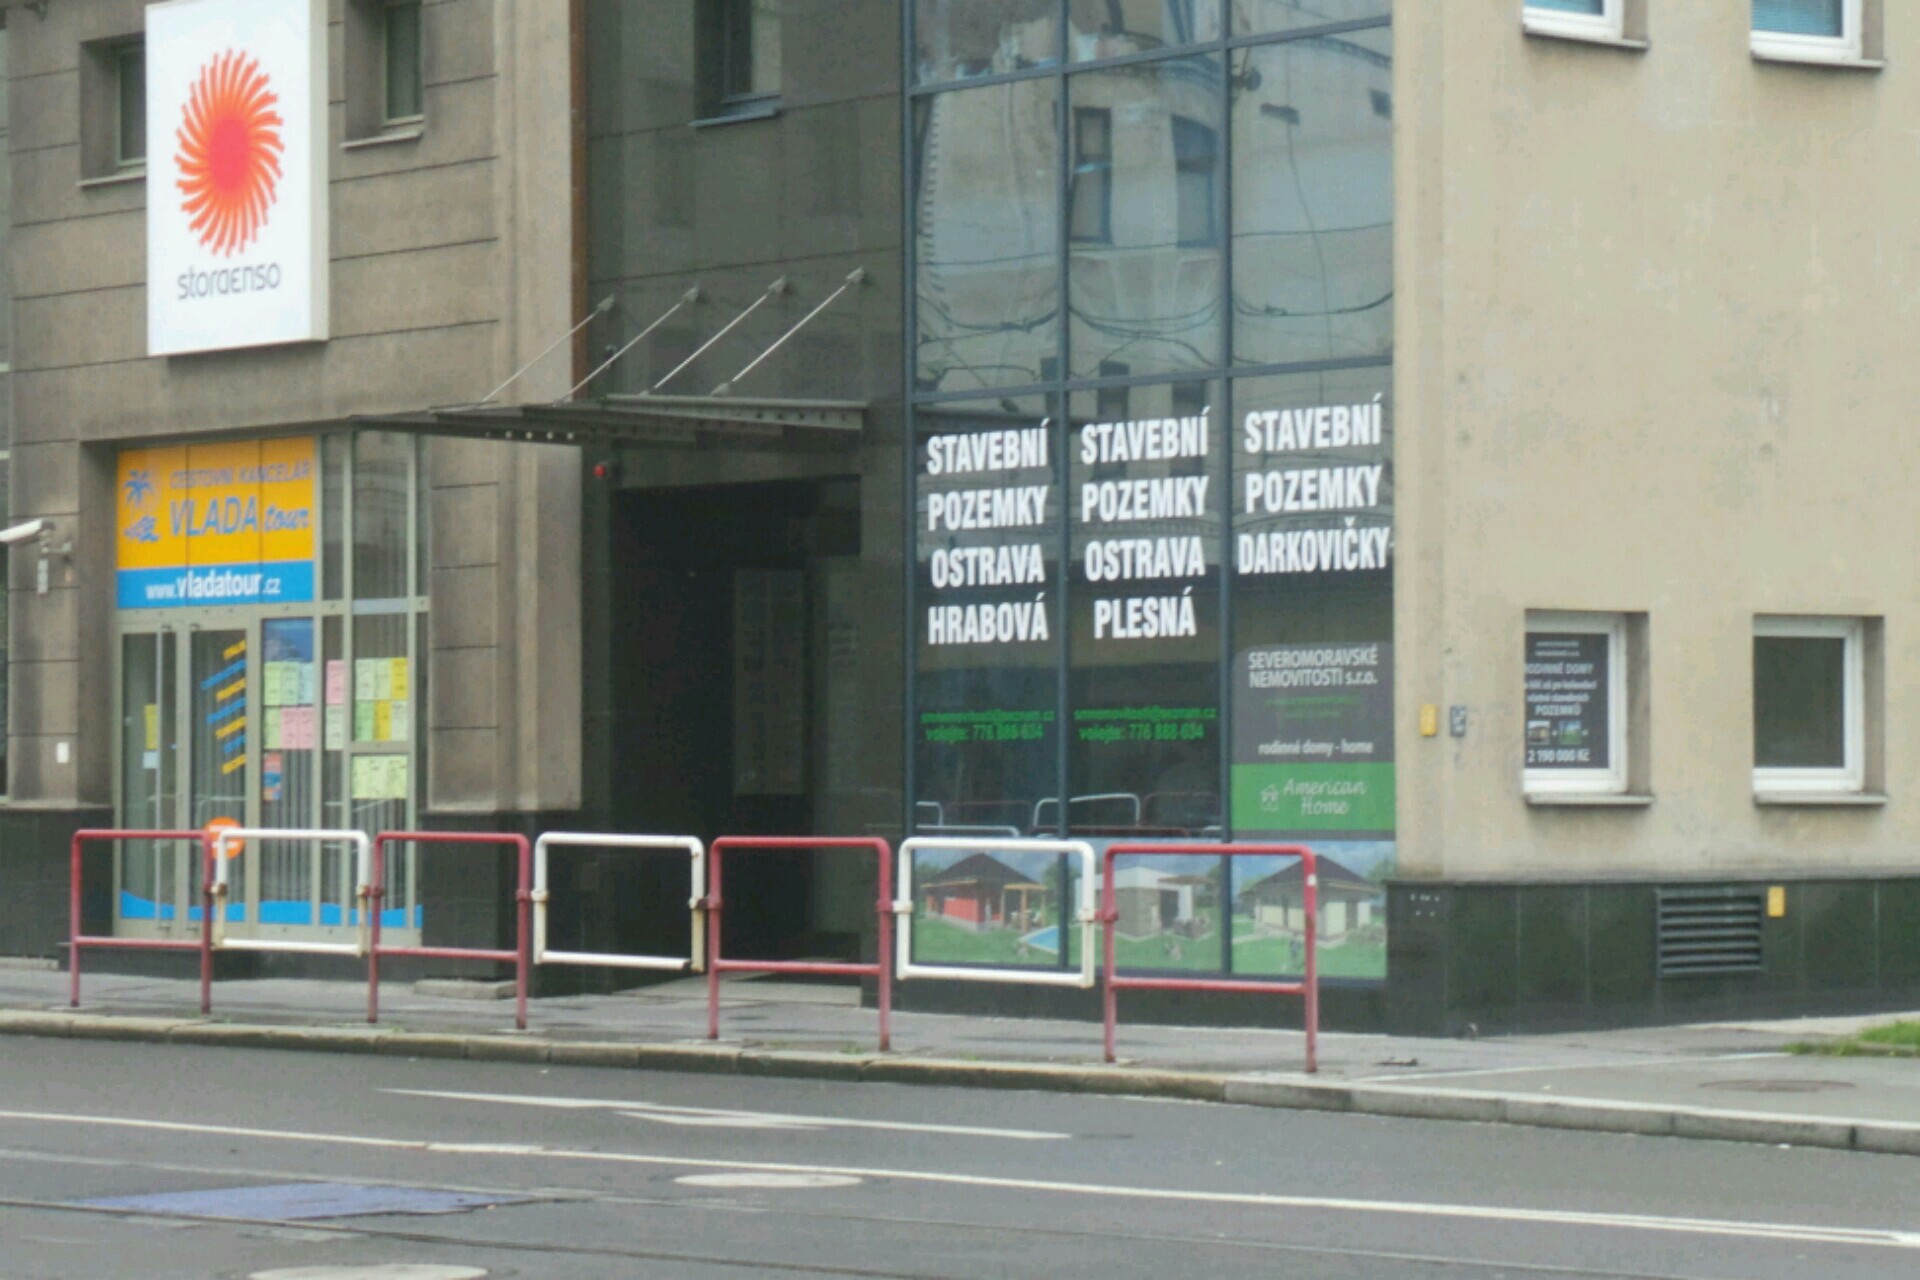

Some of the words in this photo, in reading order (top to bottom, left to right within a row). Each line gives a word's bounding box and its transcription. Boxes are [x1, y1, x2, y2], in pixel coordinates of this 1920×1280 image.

[178, 262, 281, 300] storaenso
[927, 417, 1050, 475] STAVEBNÍ
[1081, 405, 1211, 465] STAVEBNÍ
[1244, 392, 1383, 454] STAVEBNÍ
[927, 485, 1049, 531] POZEMKY
[1082, 475, 1209, 523] POZEMKY
[1245, 464, 1383, 514] POZEMKY
[170, 495, 258, 536] VLADA
[264, 503, 310, 533] tour
[931, 543, 1045, 589] OSTRAVA
[1085, 536, 1206, 581] OSTRAVA
[1238, 515, 1391, 575] DARKOVIČKY
[145, 568, 282, 600] www.vladatour.cz
[928, 592, 1049, 645] HRABOVÁ
[1094, 586, 1197, 639] PLESNÁ
[1248, 644, 1378, 669] SEVEROMORAVSKÉ
[1249, 668, 1342, 688] NEMOVITOSTI
[1345, 671, 1378, 685] s.r.o.
[1284, 778, 1367, 796] American
[1302, 796, 1349, 815] Home
